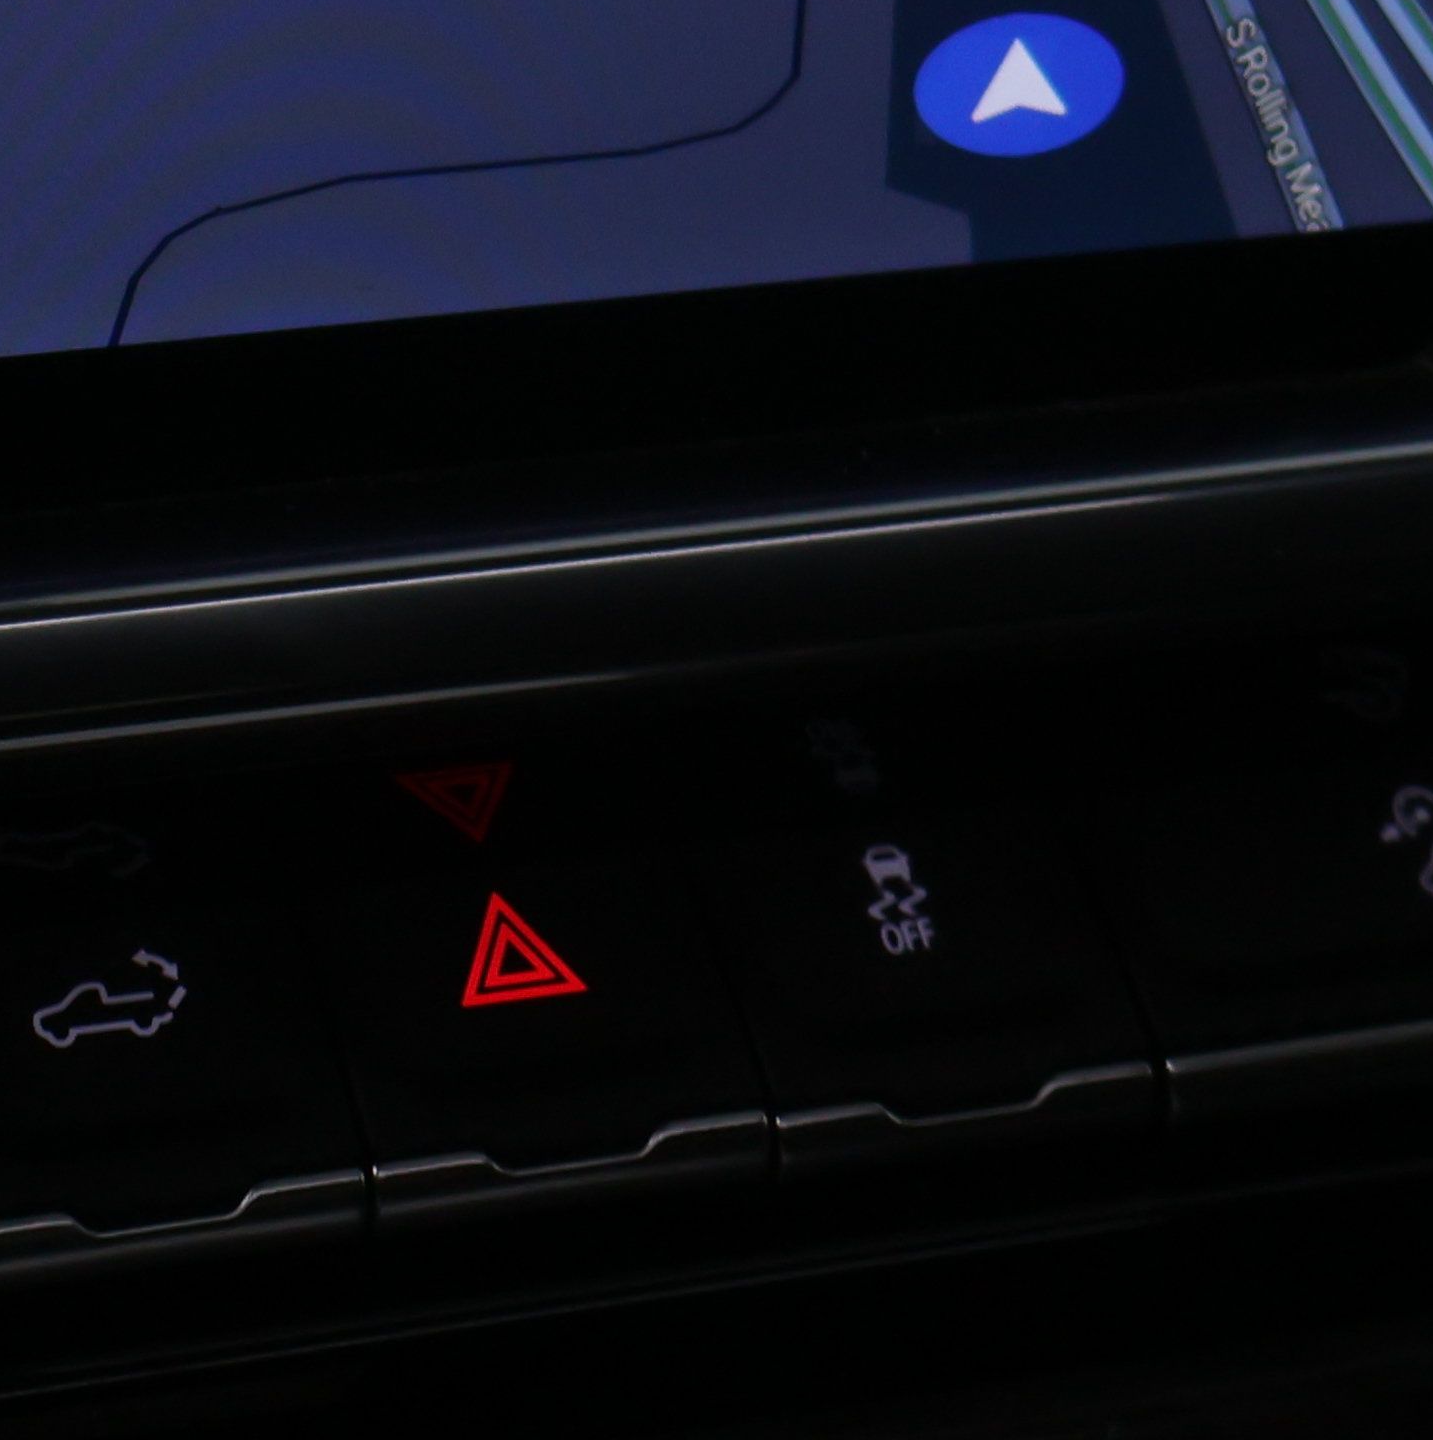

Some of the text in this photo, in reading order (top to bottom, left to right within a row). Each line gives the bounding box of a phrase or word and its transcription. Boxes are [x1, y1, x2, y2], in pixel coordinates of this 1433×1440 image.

[1226, 18, 1257, 49] S
[1237, 46, 1298, 167] Rolling
[880, 917, 934, 955] OFF
